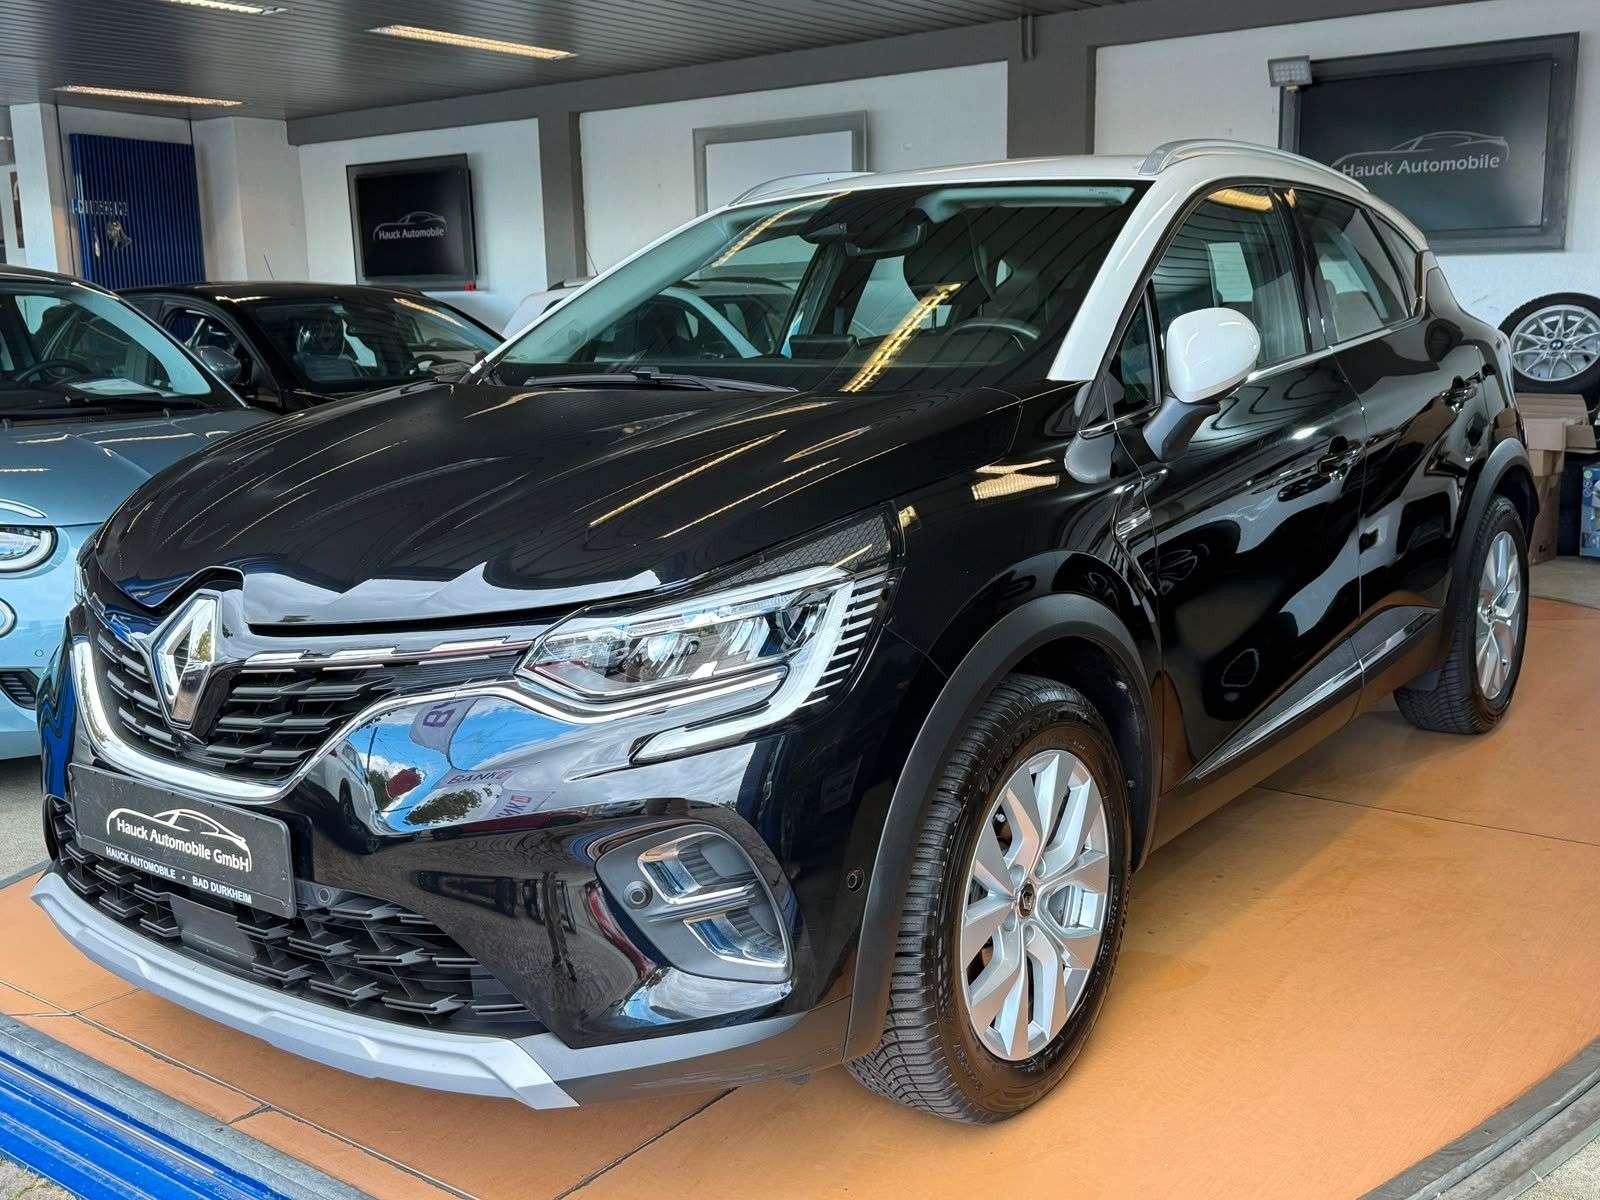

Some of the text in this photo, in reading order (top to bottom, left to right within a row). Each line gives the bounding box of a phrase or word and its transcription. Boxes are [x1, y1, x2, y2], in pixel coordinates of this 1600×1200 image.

[1342, 154, 1500, 178] Hauck Automobile
[379, 227, 444, 239] Hauck Automobile
[116, 817, 250, 873] Hauck Automobile GmbH
[105, 845, 130, 863] HAUCK
[131, 856, 177, 879] AUTOMOBILE
[192, 875, 210, 890] BAD
